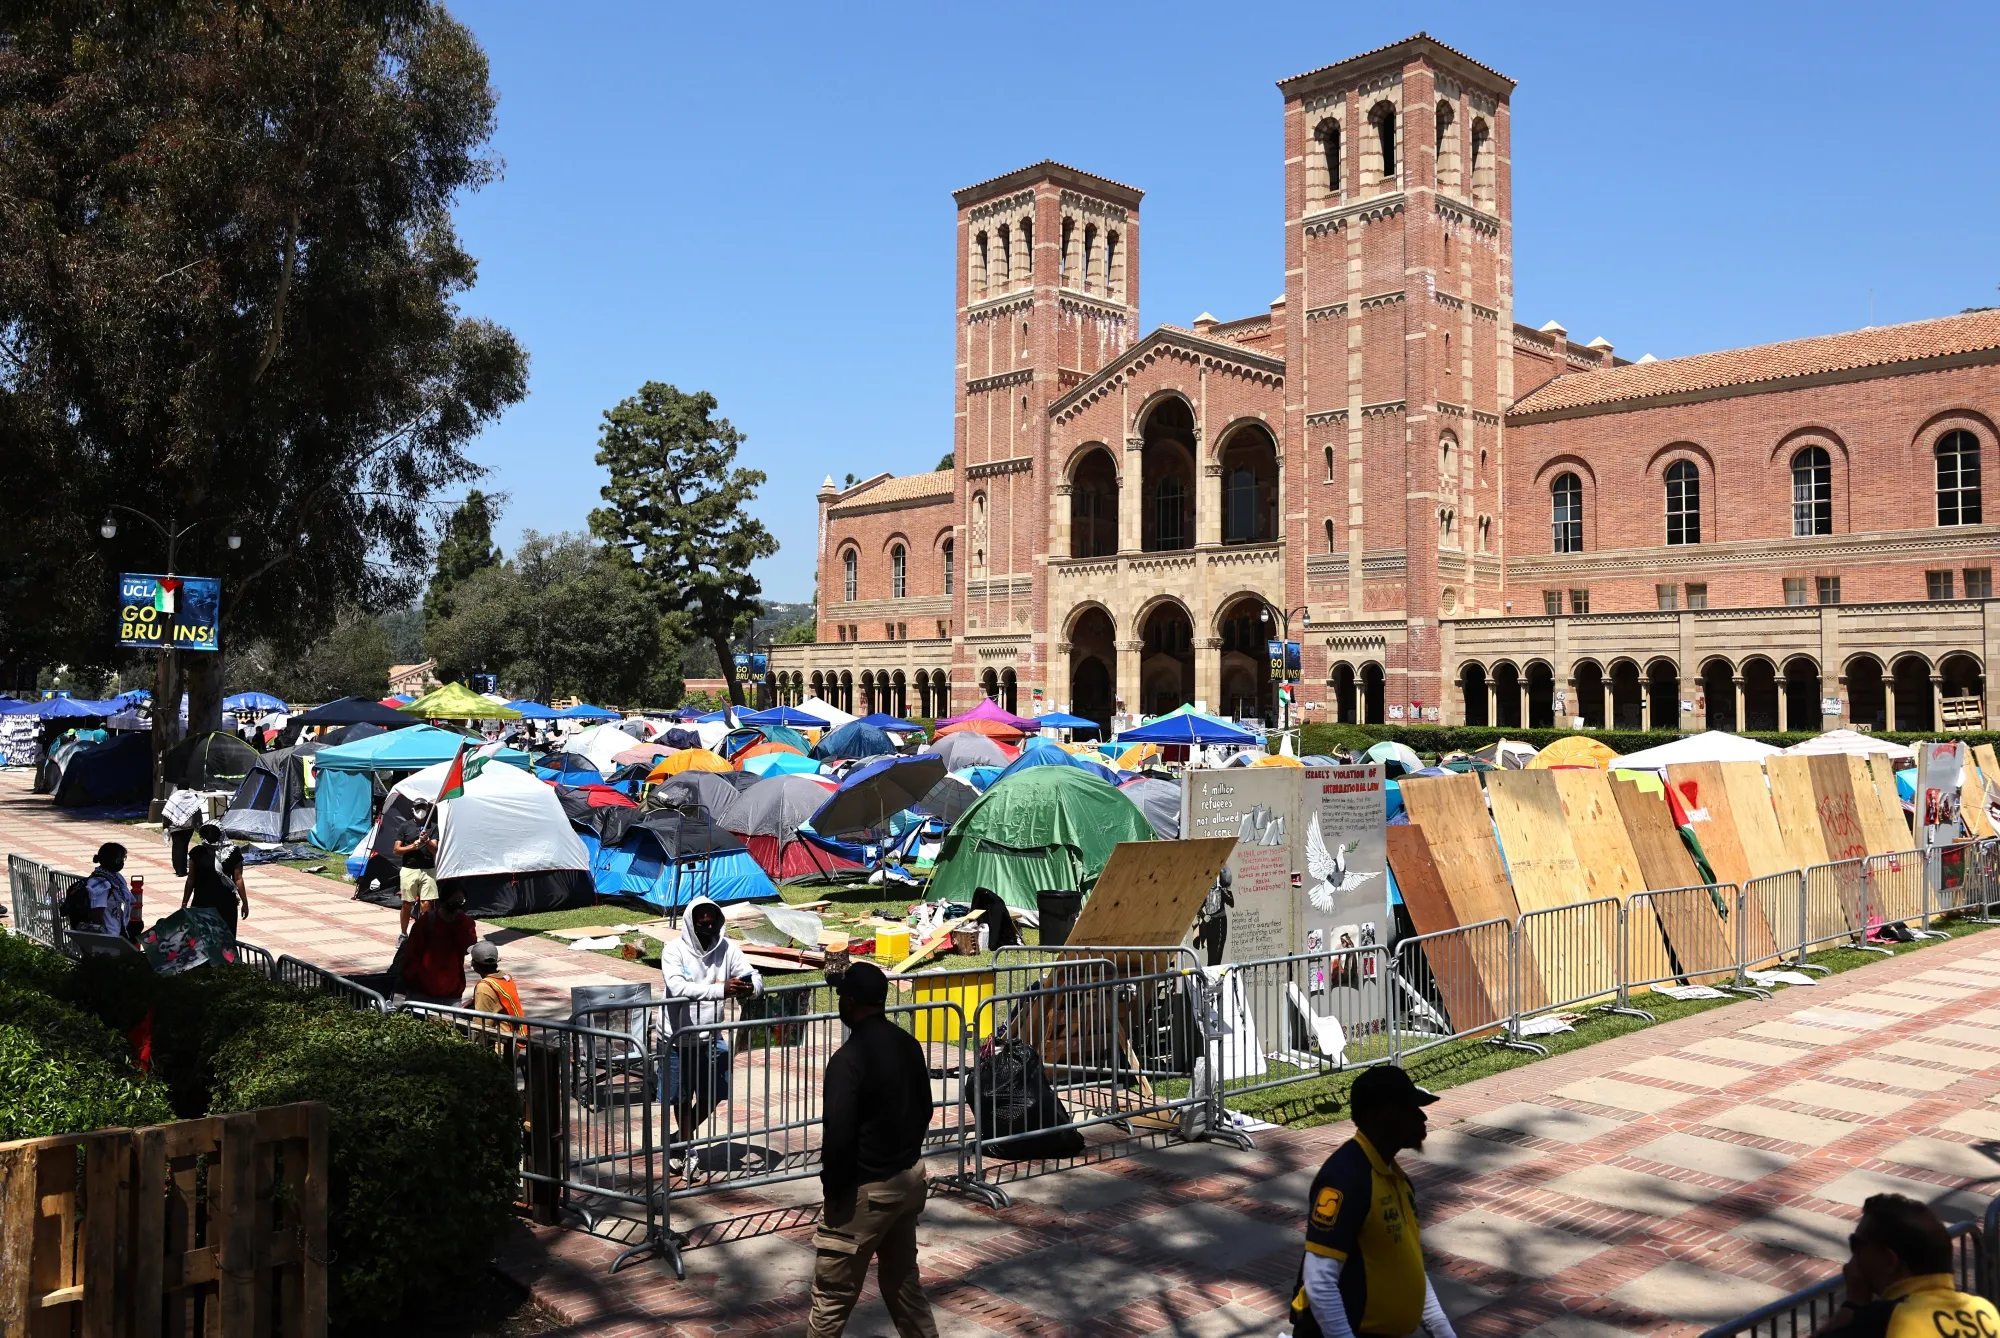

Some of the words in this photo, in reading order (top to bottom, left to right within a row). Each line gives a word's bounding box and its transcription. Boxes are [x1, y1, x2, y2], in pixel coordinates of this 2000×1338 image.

[122, 605, 157, 622] GO
[1271, 658, 1282, 668] GO
[1305, 770, 1330, 779] ISRAEL'S
[1333, 770, 1365, 779] VIOLATION
[1368, 768, 1377, 777] OF
[1202, 783, 1208, 796] 4
[1212, 783, 1234, 795] million
[1323, 783, 1366, 794] INTERNATIONAL
[1367, 783, 1379, 791] LAW
[1201, 797, 1233, 811] refugees
[1196, 818, 1209, 827] not
[1212, 811, 1239, 824] allowed
[1214, 829, 1231, 837] come
[1933, 1309, 1998, 1338] CSC
